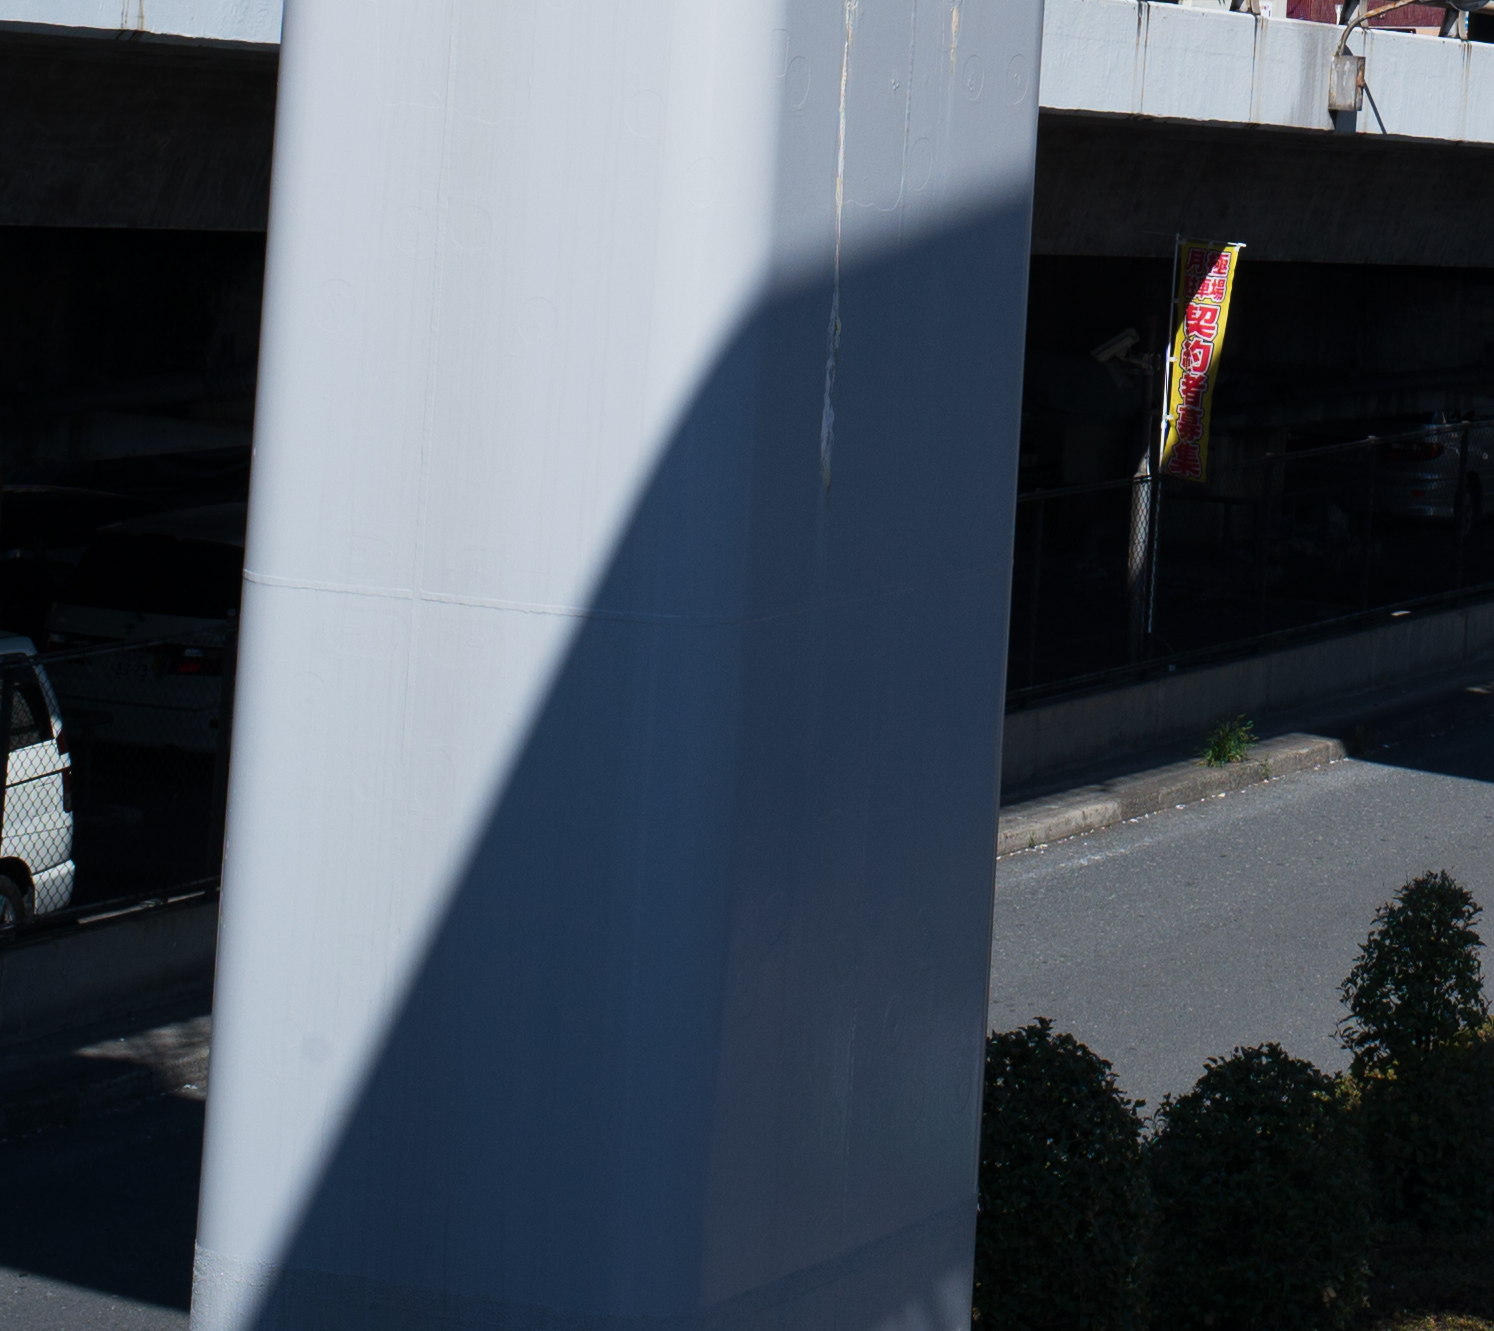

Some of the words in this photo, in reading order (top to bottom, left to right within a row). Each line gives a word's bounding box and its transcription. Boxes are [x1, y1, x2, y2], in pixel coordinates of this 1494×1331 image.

[1185, 249, 1231, 276] 月極
[1168, 303, 1221, 477] 契約者募集
